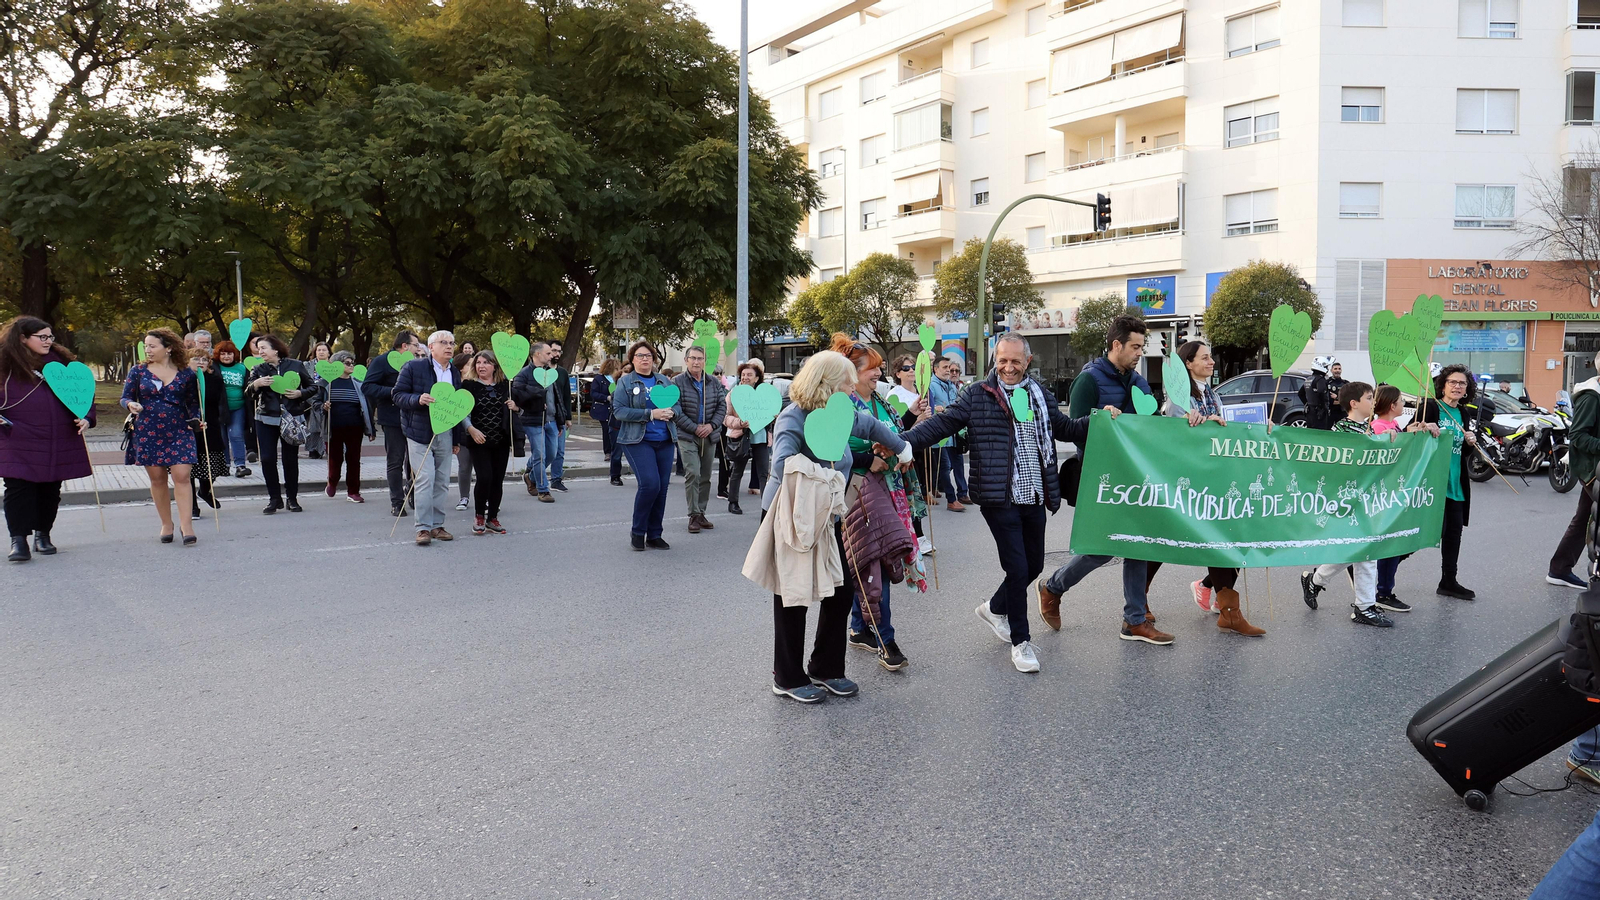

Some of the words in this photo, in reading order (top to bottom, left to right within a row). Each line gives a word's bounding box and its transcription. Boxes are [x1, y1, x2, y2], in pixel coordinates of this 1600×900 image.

[1428, 267, 1529, 279] LABORATORIO
[1452, 283, 1505, 295] DENTAL
[1443, 300, 1479, 311] EBAN
[1484, 300, 1538, 311] FLORES
[1209, 437, 1280, 460] MAREA
[1283, 442, 1355, 465] VERDE
[1356, 448, 1402, 466] JEREZ
[1096, 483, 1186, 514] ESCUELA
[1188, 486, 1255, 521] PÚBLICA:
[1262, 493, 1286, 517] DE
[1290, 492, 1352, 518] TOD@S
[1363, 490, 1403, 514] PARA
[1493, 707, 1535, 736] JBL
